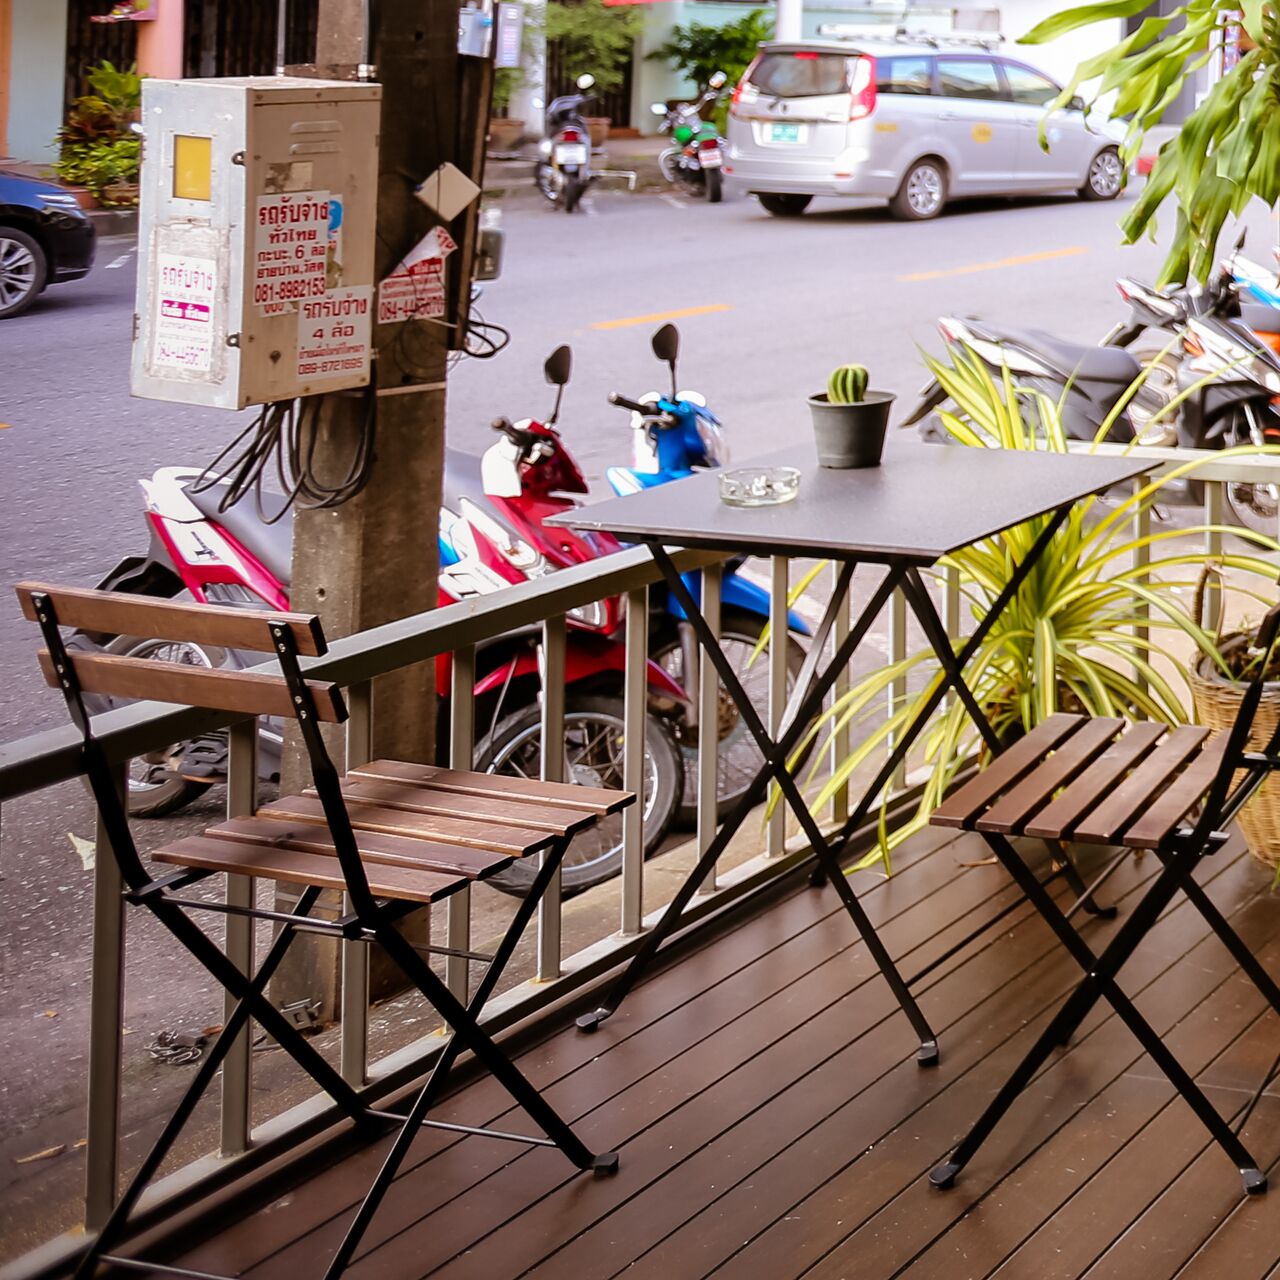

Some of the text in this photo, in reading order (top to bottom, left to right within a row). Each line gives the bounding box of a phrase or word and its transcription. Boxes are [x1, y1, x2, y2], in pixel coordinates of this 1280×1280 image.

[259, 196, 329, 225] รถรับจ้าง
[295, 245, 305, 259] 6
[303, 293, 367, 319] รถรับจ้าง
[312, 321, 354, 338] 4 ล้อ
